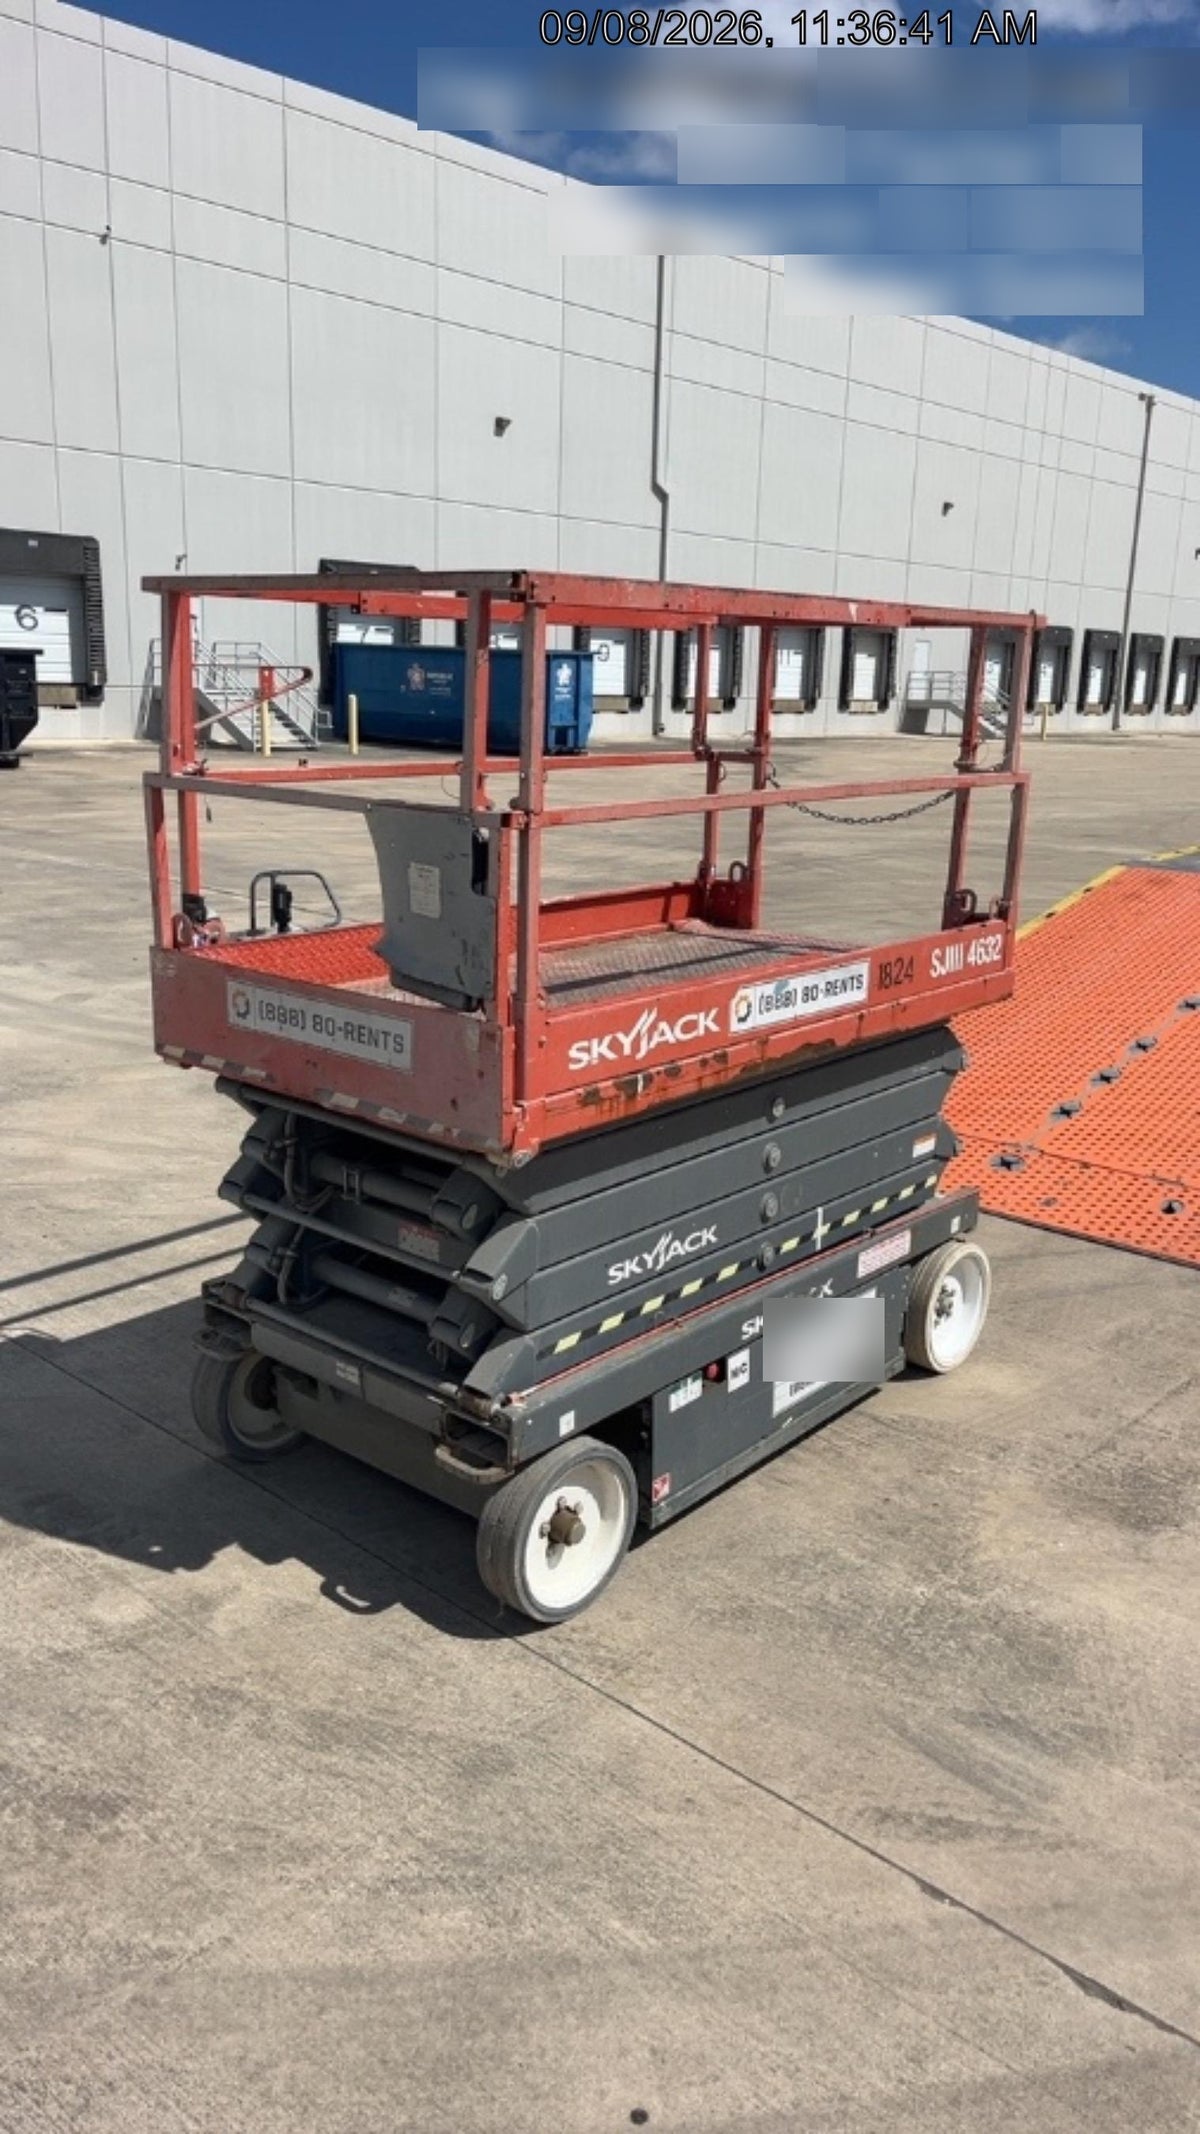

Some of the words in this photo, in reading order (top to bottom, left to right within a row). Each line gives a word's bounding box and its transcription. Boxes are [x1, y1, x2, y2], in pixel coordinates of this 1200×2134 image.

[14, 604, 39, 631] 6
[597, 643, 610, 662] 9
[967, 933, 1003, 966] 4632
[801, 973, 864, 1004] 80-RENTS
[258, 999, 306, 1031] (888)
[312, 1013, 404, 1054] 80-RENTS
[568, 1007, 721, 1071] SKYJACK
[607, 1223, 719, 1286] SKYJACK
